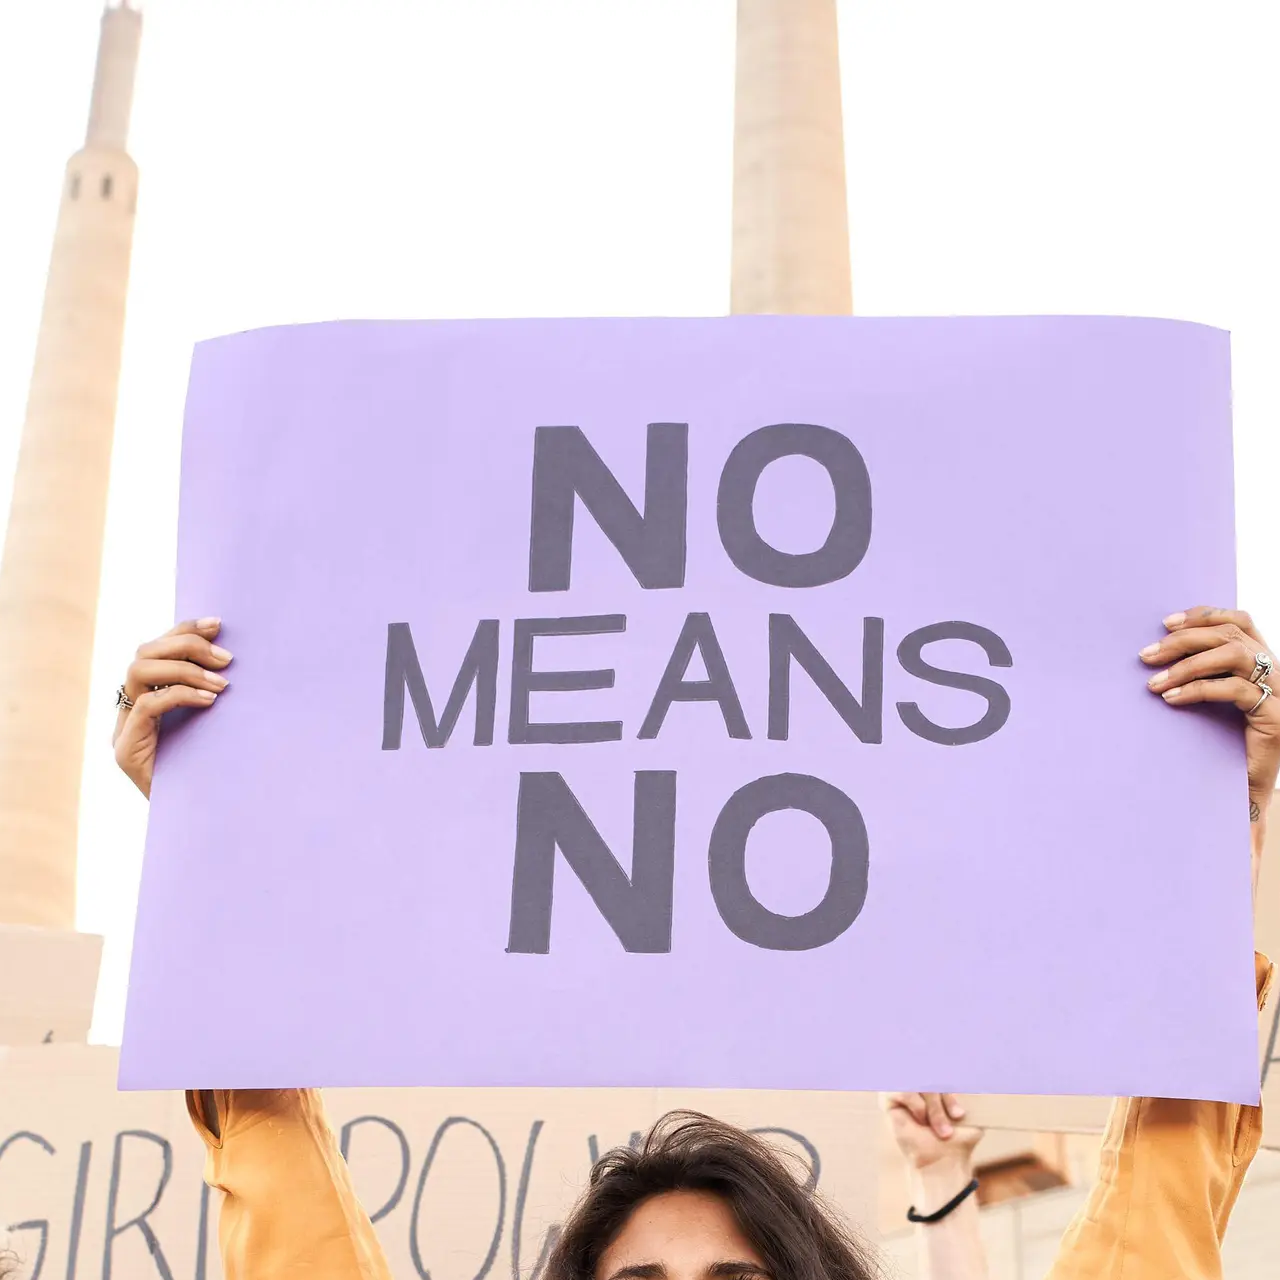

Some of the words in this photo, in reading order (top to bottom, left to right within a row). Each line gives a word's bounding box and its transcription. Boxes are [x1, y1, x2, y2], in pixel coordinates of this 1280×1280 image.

[528, 422, 873, 592] NO
[381, 612, 1013, 750] MEANS
[505, 770, 870, 954] NO
